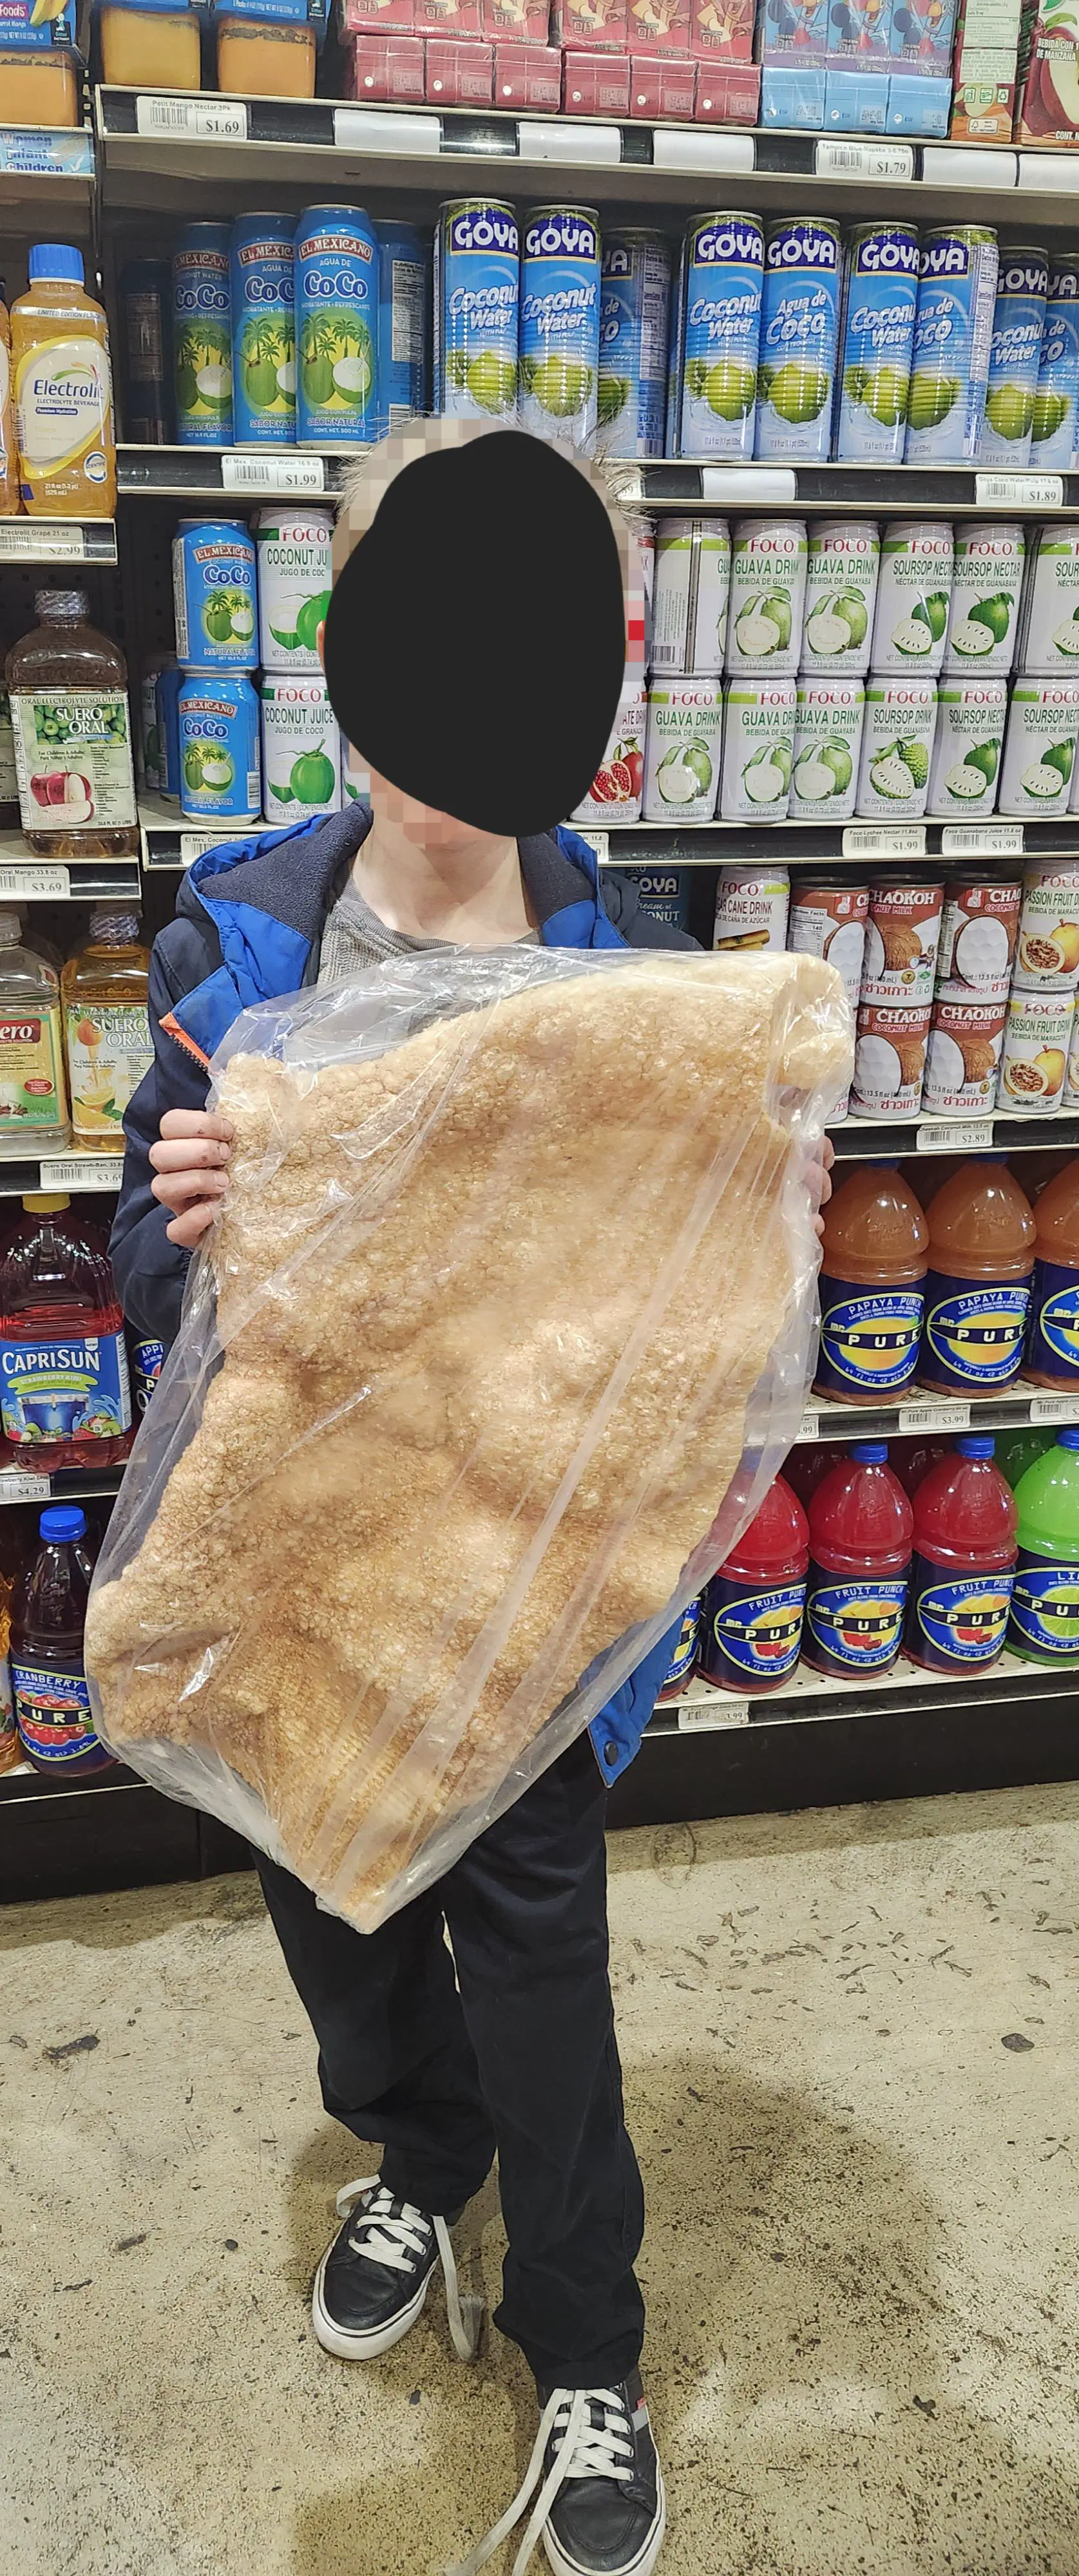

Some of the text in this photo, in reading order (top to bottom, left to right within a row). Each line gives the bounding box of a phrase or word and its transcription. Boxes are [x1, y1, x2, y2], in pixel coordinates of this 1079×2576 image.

[1060, 39, 1074, 50] CON
[1045, 51, 1076, 61] MANZANA
[205, 120, 239, 133] $1.69
[5, 162, 63, 172] Children
[877, 161, 906, 174] $1.79
[454, 221, 519, 249] GOYA
[526, 228, 595, 254] GOYA
[242, 249, 254, 261] EL
[301, 238, 371, 258] EL MEXICANO
[698, 234, 763, 261] GOYA
[767, 239, 836, 267] GOYA
[320, 258, 351, 267] AGUA DE
[862, 244, 919, 270] GOYA
[262, 264, 282, 272] AGUA
[522, 283, 597, 321] Coconut
[690, 292, 762, 325] Coconut
[776, 289, 827, 316] Agua de
[935, 297, 954, 315] de
[470, 308, 513, 330] Water
[537, 312, 583, 336] Water
[709, 317, 753, 340] Water
[872, 326, 911, 347] Water
[995, 345, 1036, 366] Water
[307, 417, 366, 428] SABOR NATURAL
[285, 474, 316, 486] $1.99
[1029, 491, 1056, 502] $1.89
[282, 527, 327, 542] FOCO
[750, 538, 795, 553] FOCO
[824, 539, 867, 553] FOCO
[912, 540, 950, 554] FOCO
[969, 542, 1013, 556] FOCO
[197, 549, 209, 559] EL
[267, 549, 314, 565] COCONUT
[280, 568, 310, 577] JUGO DE
[735, 558, 772, 575] GUAVA
[808, 559, 876, 575] GUAVA DRINK
[893, 560, 932, 576] SOURSOP
[953, 561, 1020, 577] SOURSOP NECTAR
[278, 688, 321, 703] FOCO
[672, 692, 712, 706] FOCO
[760, 692, 795, 706] FOCO
[808, 691, 851, 705] FOCO
[888, 690, 929, 705] FOCO
[964, 690, 1002, 705] FOCO
[1042, 690, 1079, 704] FOCO
[56, 707, 104, 721] SUERO
[187, 700, 235, 715] MEXICANO
[265, 709, 334, 724] COCONUT JUICE
[656, 710, 721, 726] GUAVA DRINK
[741, 710, 779, 726] GUAVA
[795, 709, 861, 725] GUAVA DRINK
[873, 709, 913, 724] SOURSOP
[948, 709, 986, 724] SOURSOP
[1023, 708, 1064, 724] SOURSOP
[68, 721, 109, 734] ORAL
[892, 841, 918, 851] $1.99
[992, 840, 1017, 849] $1.99
[32, 882, 62, 892] $3.69
[721, 881, 759, 896] FOCO
[1041, 875, 1079, 888] FOCO
[1026, 890, 1074, 906] PASSION FRUIT
[728, 900, 773, 915] CANE DRINK
[892, 906, 913, 915] MILK
[749, 915, 770, 923] AZÚCAR
[941, 1006, 1005, 1021] CHAOKOH
[1024, 1003, 1067, 1016] FOCO
[91, 1018, 149, 1033] SUERO
[872, 1024, 907, 1033] COCONUT
[972, 1020, 991, 1030] MILK
[1008, 1017, 1056, 1034] PASSION FRUIT
[106, 1032, 155, 1047] ORAL
[962, 1133, 985, 1144] $2.89
[848, 1298, 893, 1315] PAPAYA
[900, 1296, 922, 1309] PUNCH
[958, 1291, 1029, 1310] PAPAYA PUNCH
[848, 1328, 920, 1348] PURE
[957, 1323, 1025, 1343] PURE
[942, 1416, 964, 1425] $3.99
[18, 1486, 44, 1495] $4.29
[835, 1585, 905, 1599] FRUIT PUNCH
[951, 1580, 988, 1596] FRUIT
[749, 1594, 783, 1611] FRUIT
[833, 1611, 903, 1631] PURE
[15, 1670, 81, 1690] CRANBERRY
